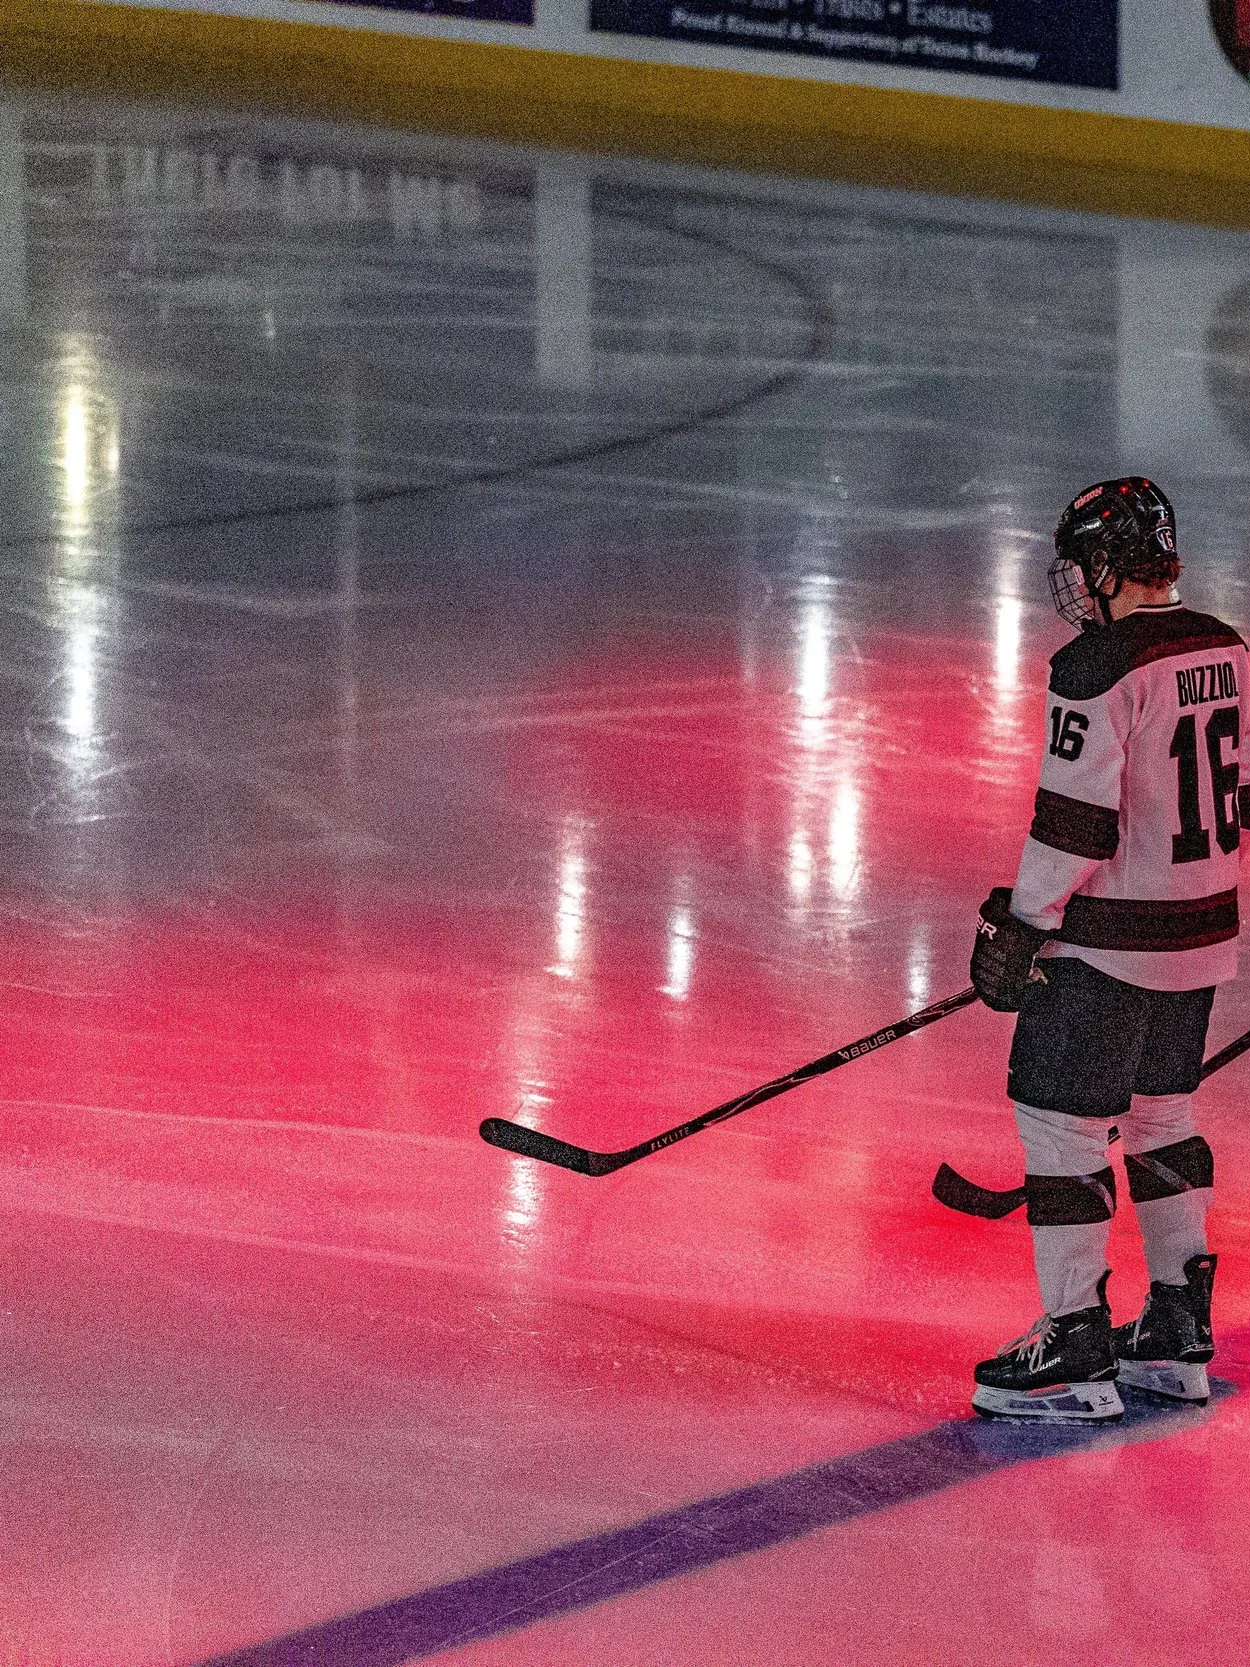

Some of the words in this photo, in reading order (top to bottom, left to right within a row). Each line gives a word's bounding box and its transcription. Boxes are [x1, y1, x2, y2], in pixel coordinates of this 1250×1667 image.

[1049, 706, 1090, 762] 16
[1169, 704, 1241, 865] 16
[850, 1029, 897, 1057] BAUER
[651, 1126, 690, 1151] FLYLITE
